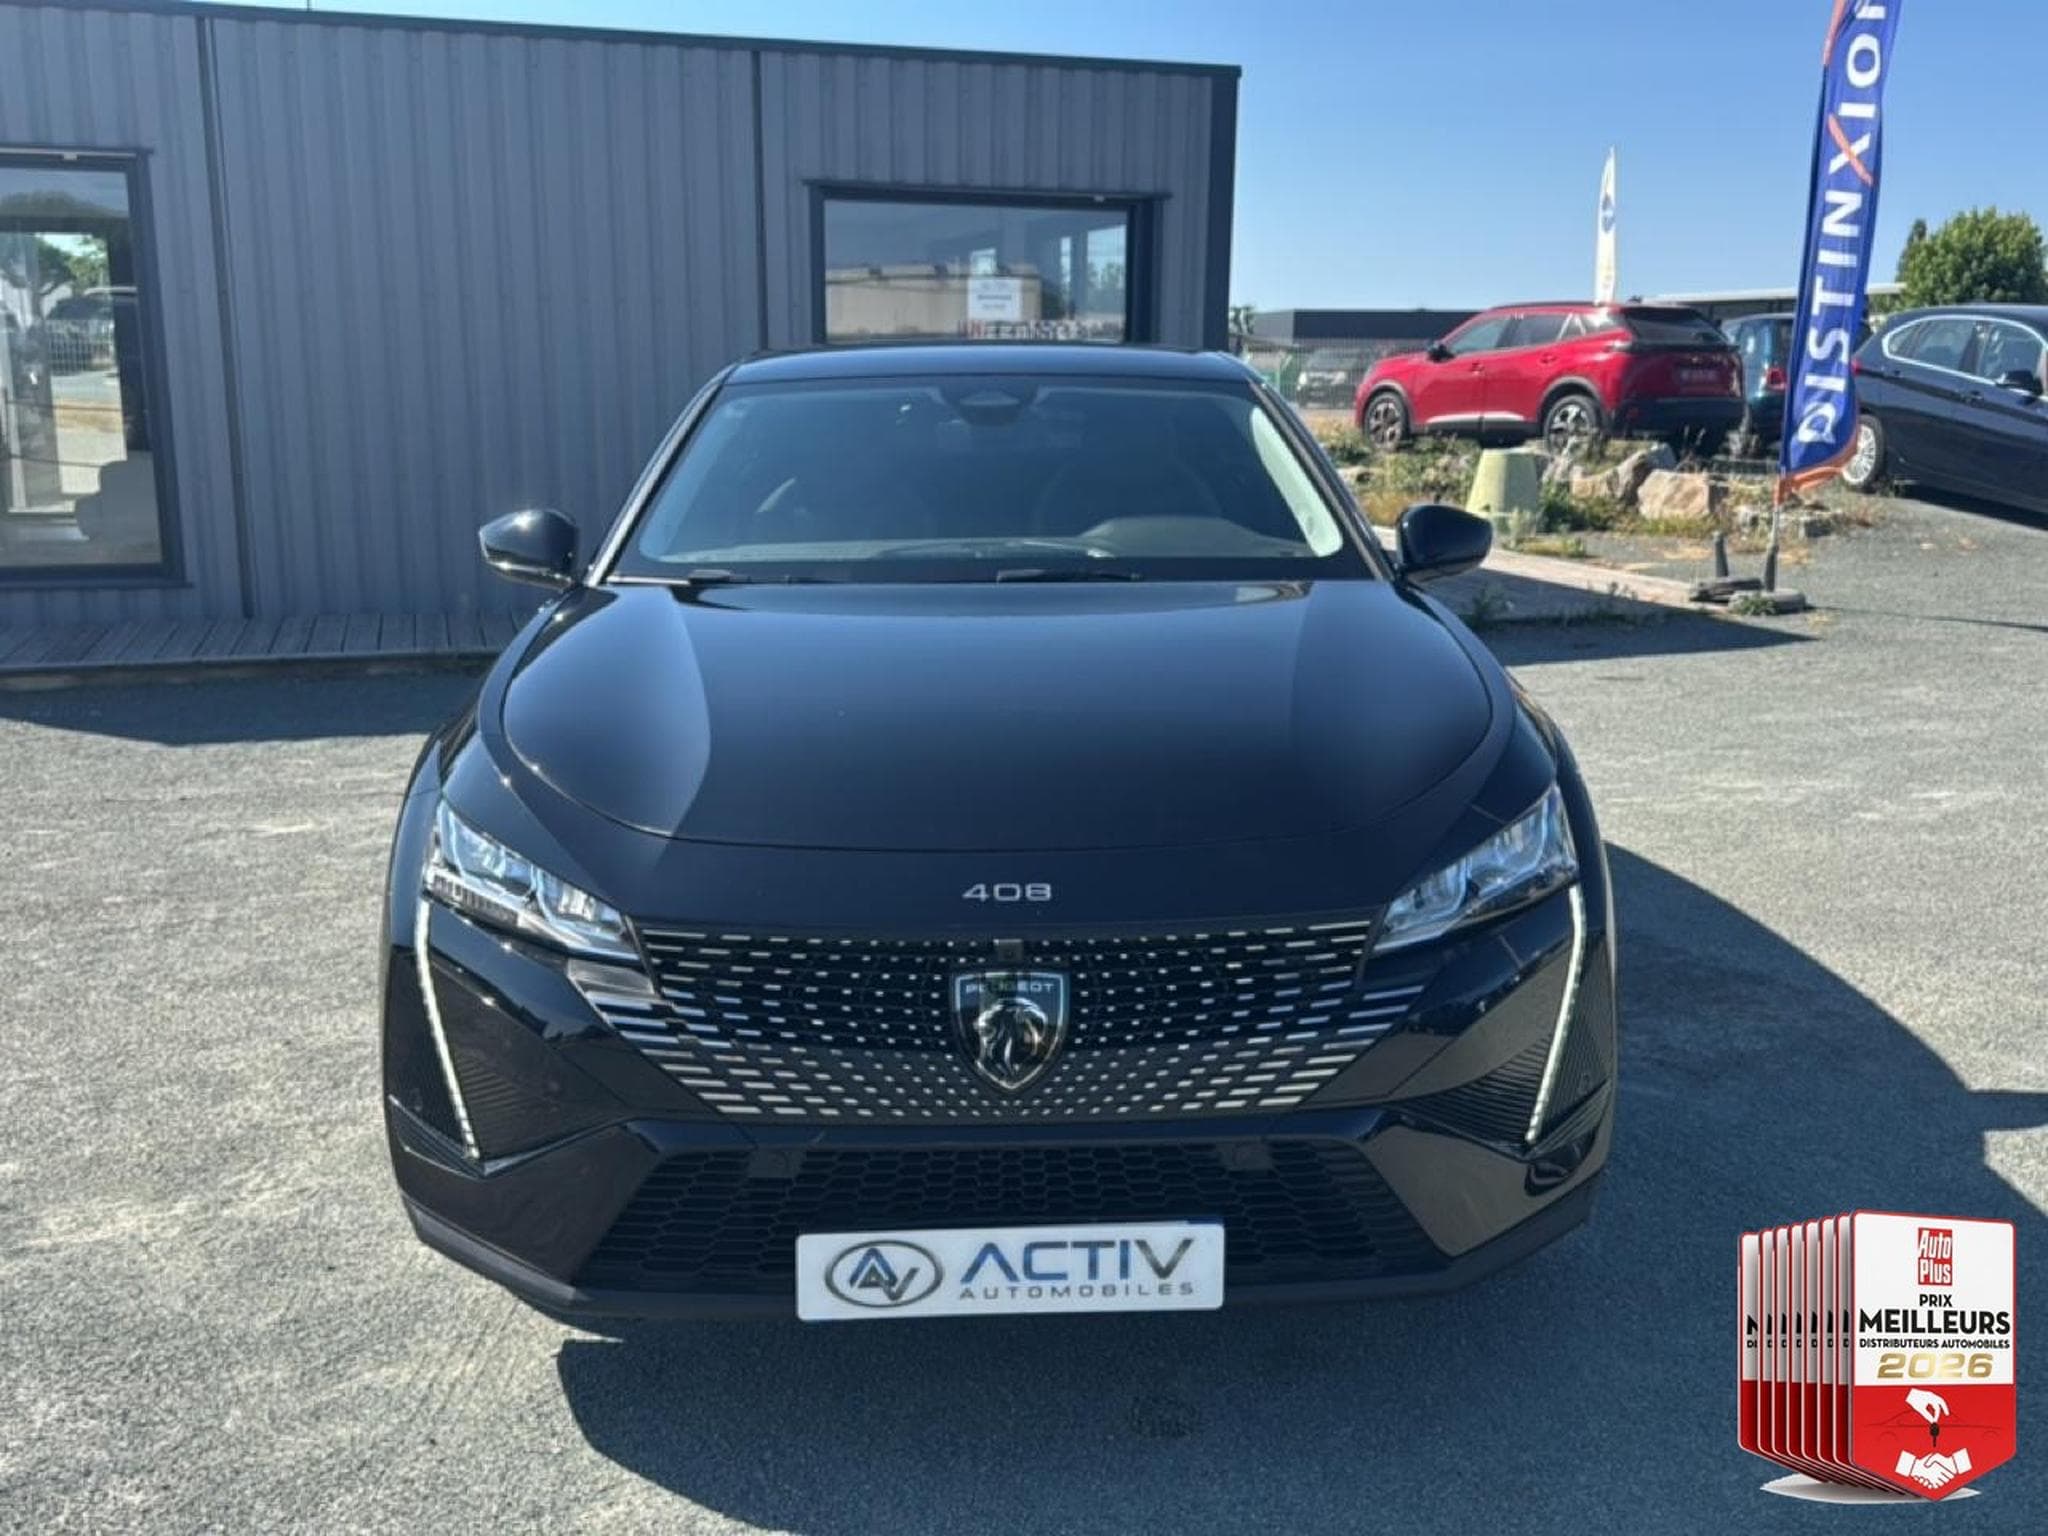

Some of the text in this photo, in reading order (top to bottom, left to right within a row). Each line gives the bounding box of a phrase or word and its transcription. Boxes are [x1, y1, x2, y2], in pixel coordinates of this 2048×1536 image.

[962, 883, 1051, 901] 408
[960, 1238, 1195, 1284] ACTIV
[960, 1282, 1195, 1301] AUTOMOBILES
